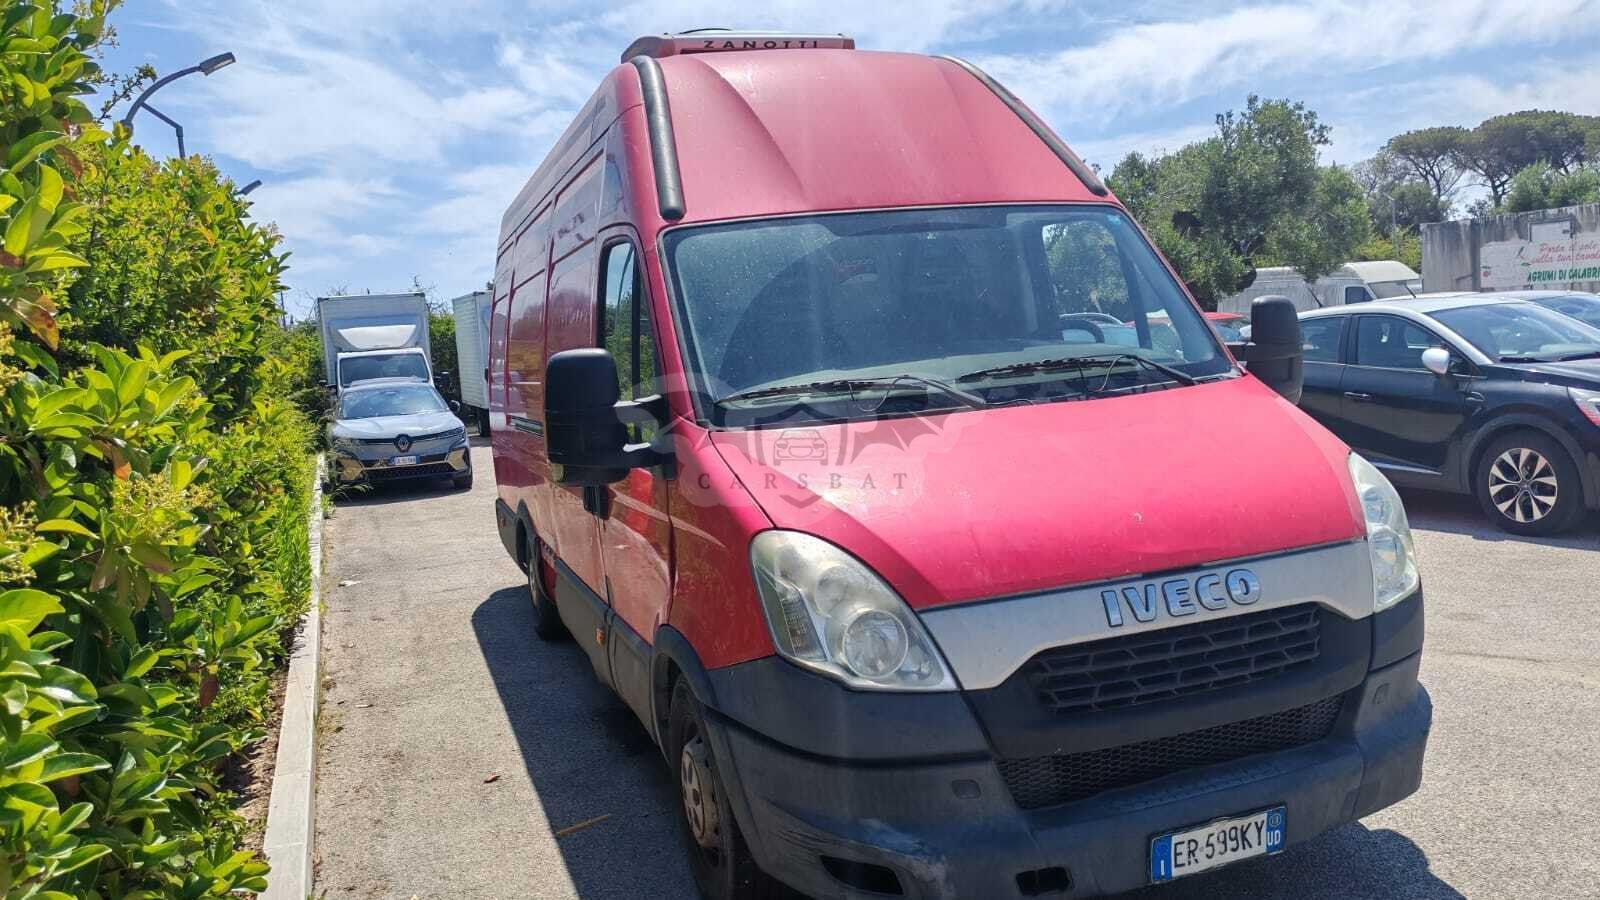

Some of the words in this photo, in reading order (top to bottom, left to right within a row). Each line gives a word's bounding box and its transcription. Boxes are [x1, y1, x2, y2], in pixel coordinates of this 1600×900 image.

[703, 40, 818, 49] ZANOTTI
[1527, 270, 1556, 281] AGRUMI
[1558, 269, 1567, 280] DI
[1101, 568, 1262, 627] IVECO
[1267, 829, 1281, 847] UD
